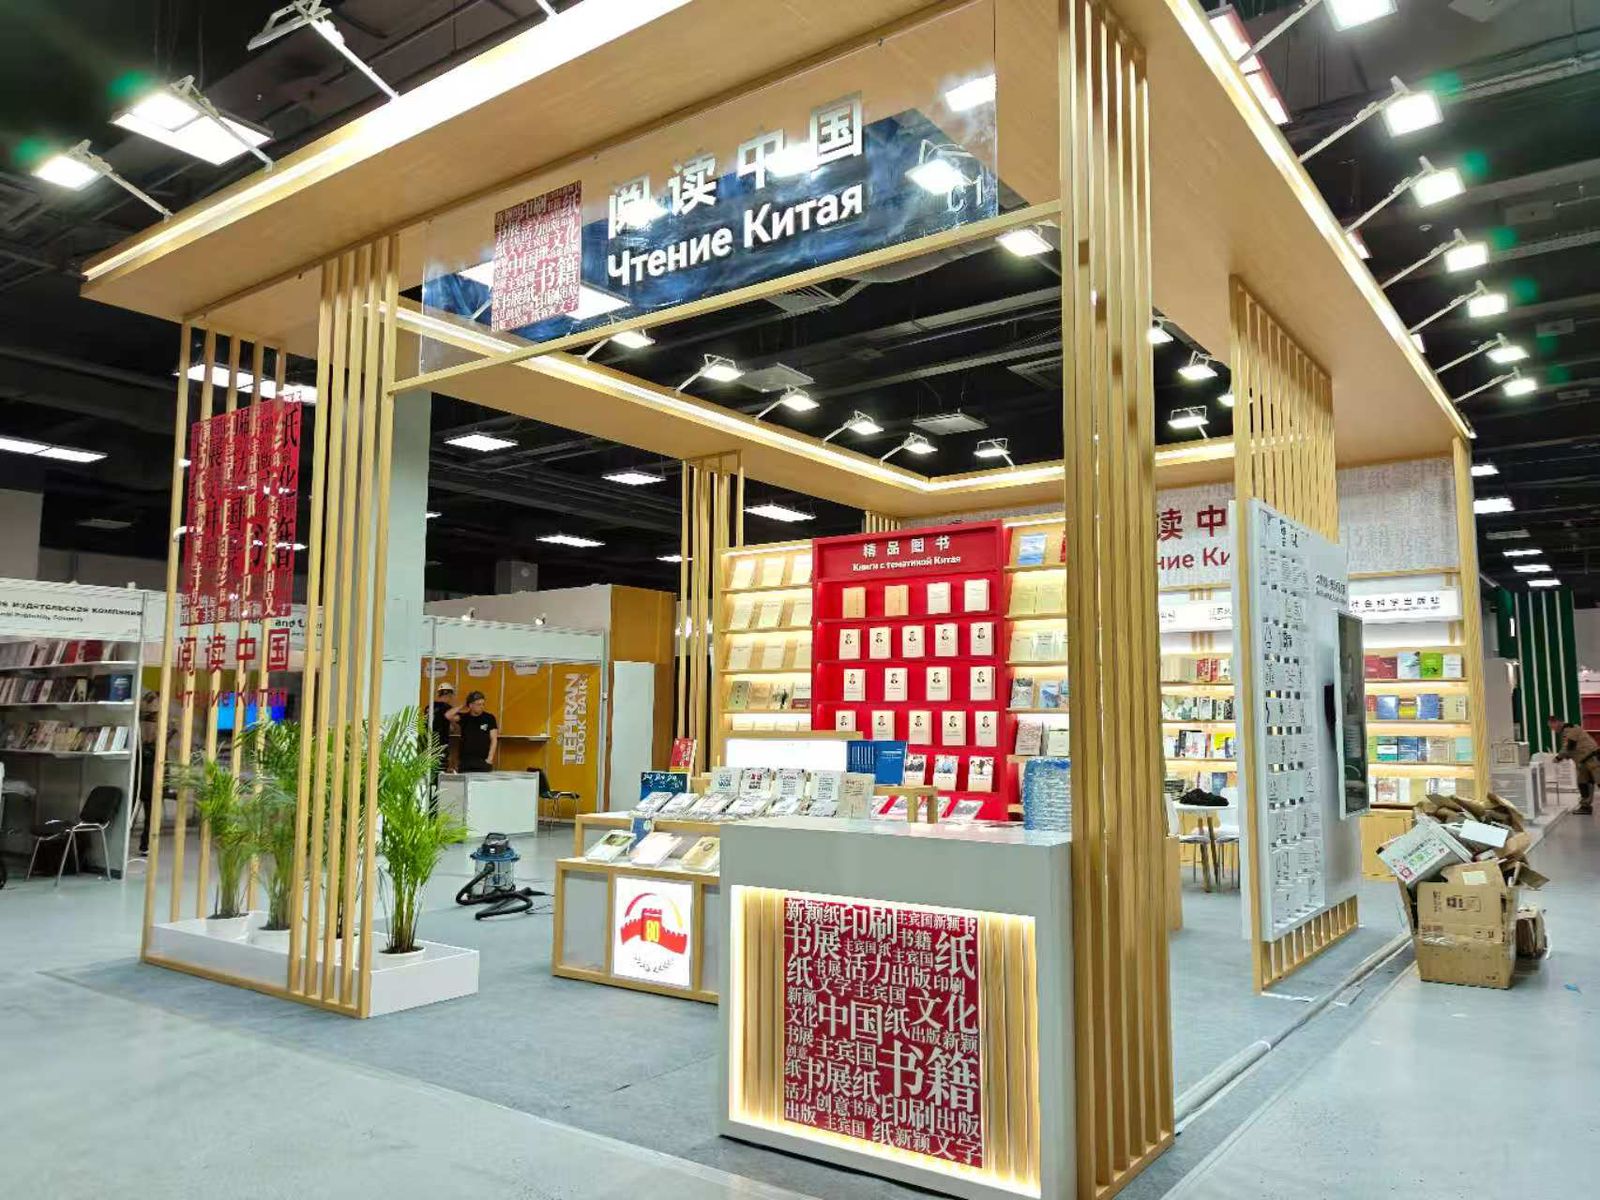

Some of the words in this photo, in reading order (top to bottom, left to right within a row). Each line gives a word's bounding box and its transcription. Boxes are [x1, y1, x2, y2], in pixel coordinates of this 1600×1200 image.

[607, 92, 863, 239] 阅读中国
[607, 226, 733, 286] Чтение
[743, 184, 863, 248] Китая
[177, 627, 290, 677] 阅读中国
[562, 673, 579, 765] TEHRAN
[787, 898, 823, 924] 新颖
[840, 905, 898, 943] 印刷
[784, 921, 841, 960] 书展
[898, 928, 932, 950] 书籍
[935, 931, 976, 980] 纸
[787, 953, 813, 989] 纸
[814, 958, 842, 979] 书展
[844, 950, 891, 984] 活力
[893, 948, 933, 968] 主宾国
[815, 977, 852, 997] 文字
[892, 962, 932, 990] 出版
[934, 974, 965, 995] 印刷
[853, 981, 906, 1006] 主宾国
[785, 1004, 818, 1027] 文化
[818, 996, 883, 1045] 中国
[885, 1005, 910, 1038] 纸
[908, 988, 978, 1034] 文化
[815, 1033, 877, 1069] 主宾国
[912, 1024, 942, 1046] 出版
[943, 1029, 978, 1055] 新颖
[785, 1059, 802, 1079] 纸
[800, 1056, 852, 1097] 书展
[853, 1067, 882, 1104] 纸
[877, 1040, 979, 1113] 书籍
[785, 1100, 816, 1125] 出版
[816, 1091, 850, 1116] 创意
[879, 1093, 935, 1134] 印刷
[873, 1117, 894, 1147] 纸
[937, 1106, 980, 1137] 出版
[931, 1130, 982, 1164] 文字
